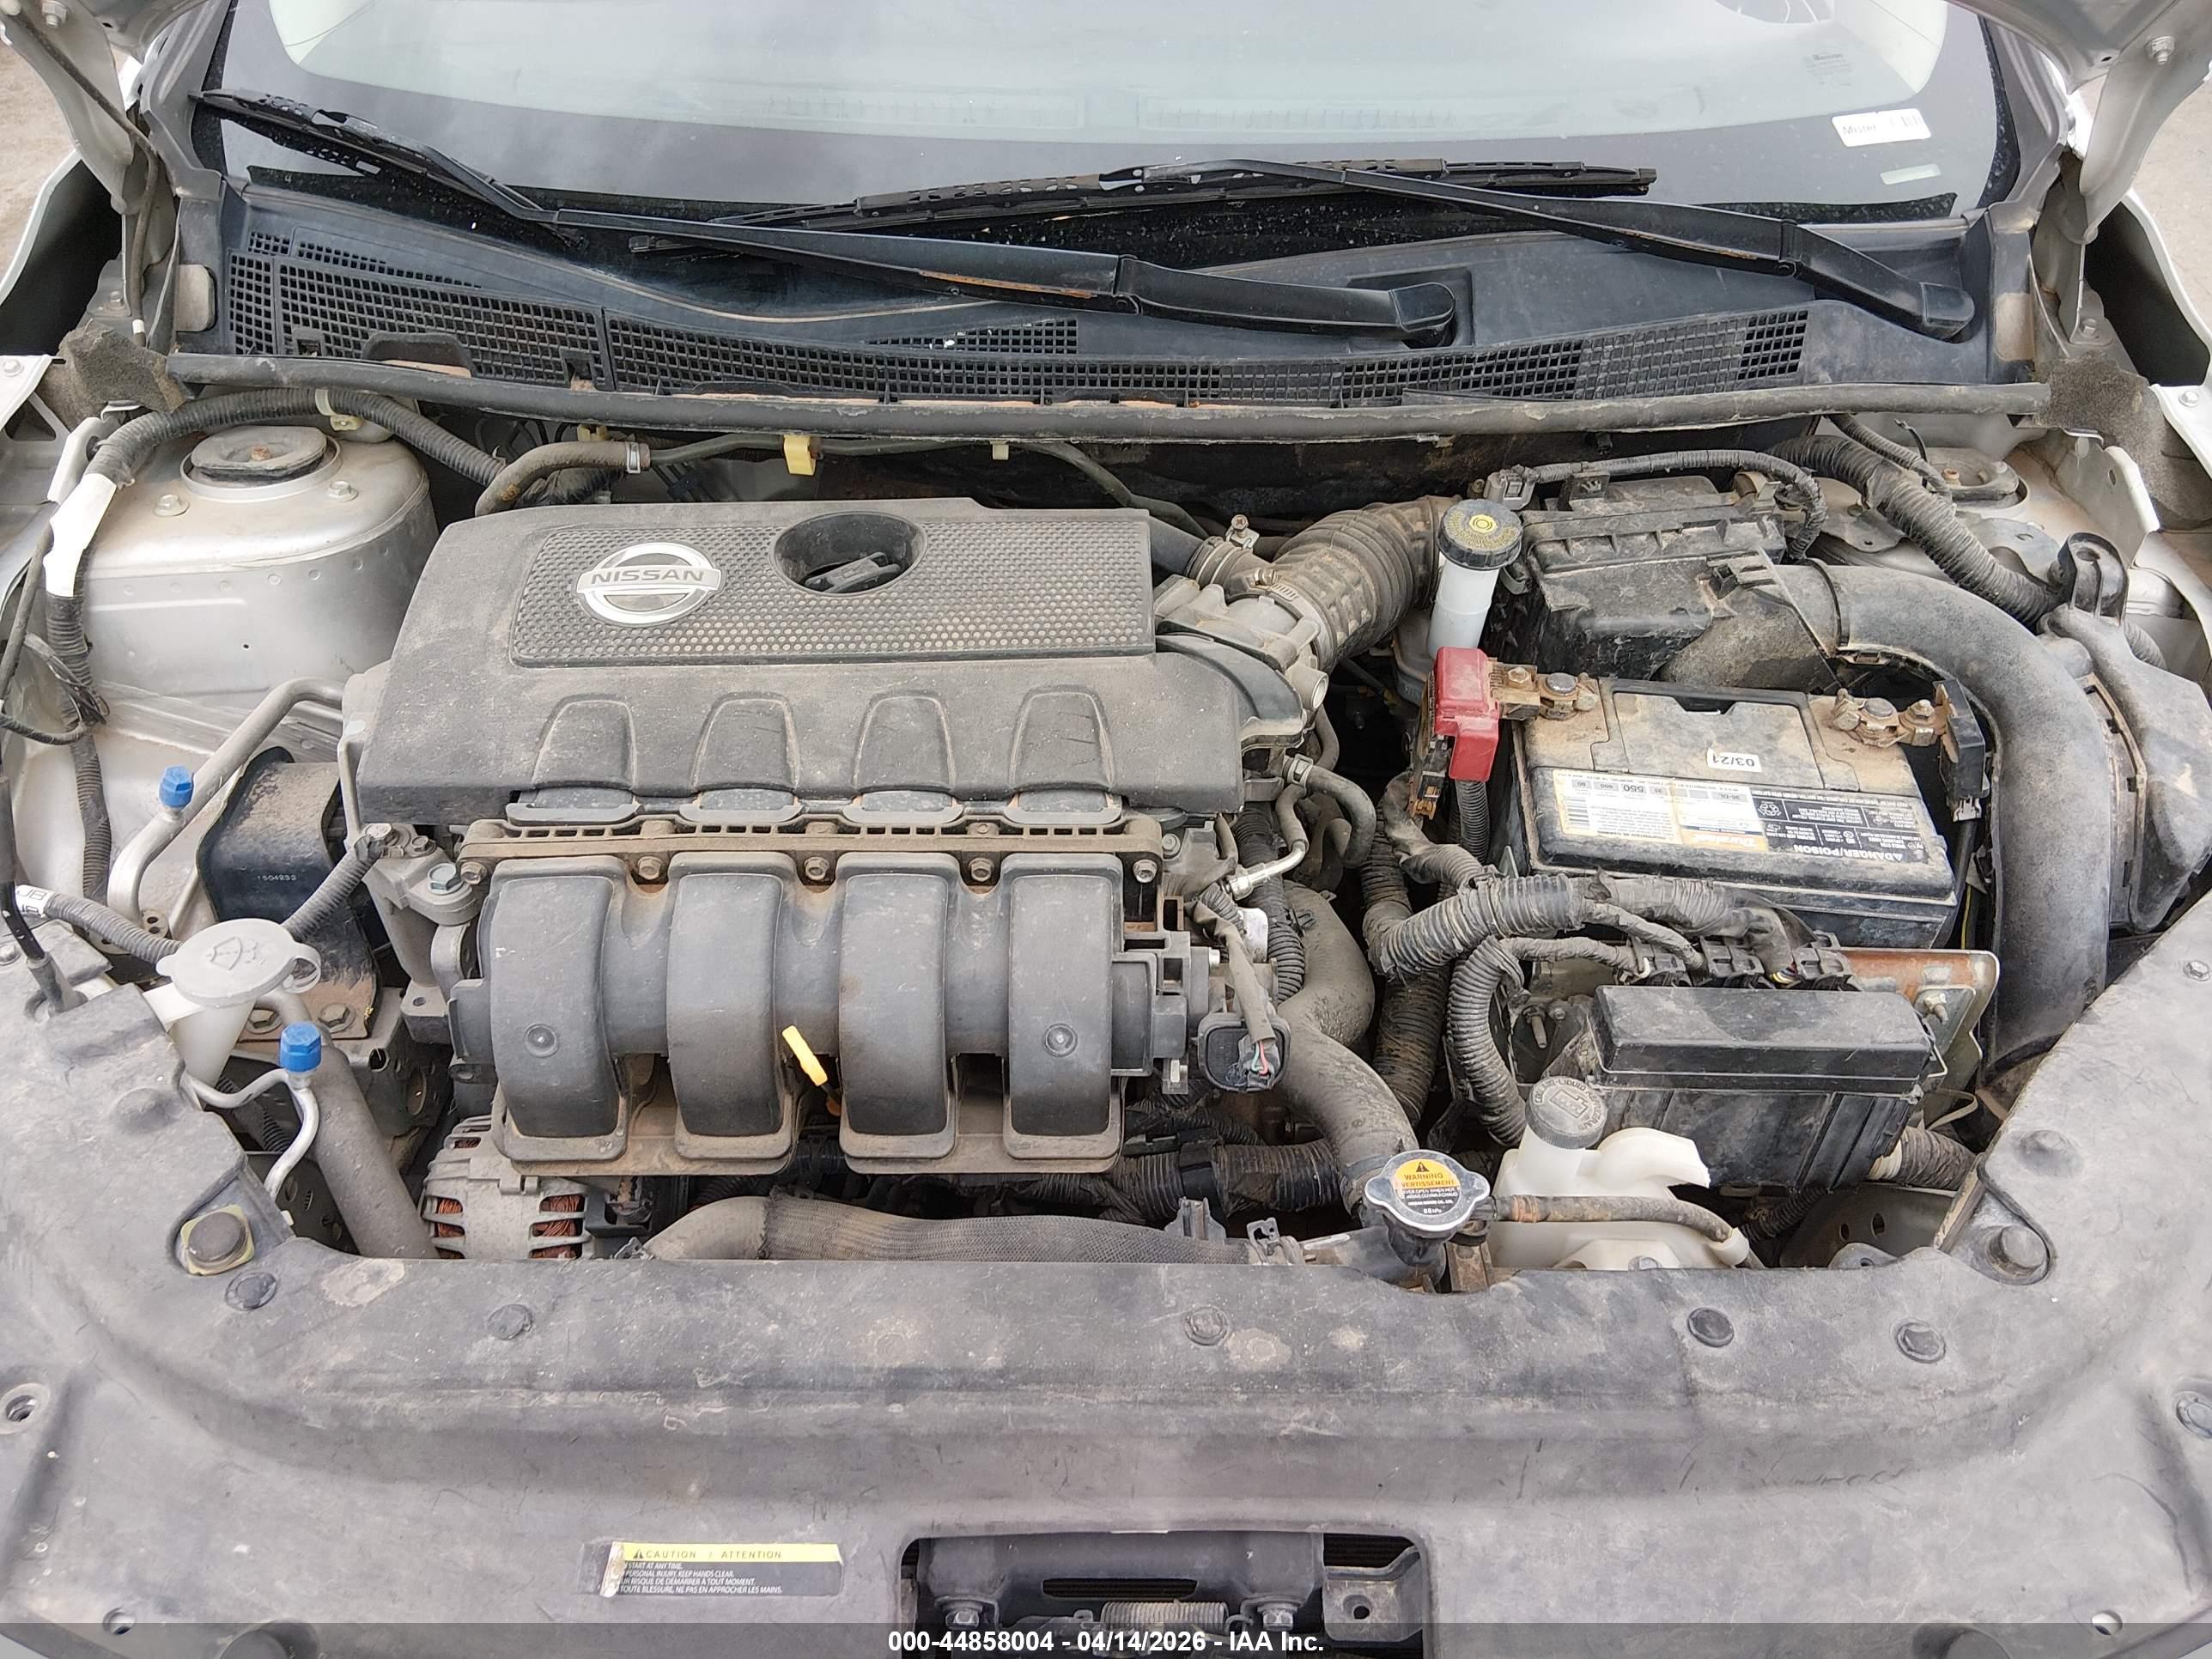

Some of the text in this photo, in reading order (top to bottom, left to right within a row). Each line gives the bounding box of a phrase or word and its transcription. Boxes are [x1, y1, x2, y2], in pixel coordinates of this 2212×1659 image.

[591, 568, 704, 585] NISSAN
[1712, 755, 1755, 767] 03/21
[1622, 784, 1644, 793] 550
[1793, 844, 1893, 861] DANGER/POISON
[1404, 1172, 1443, 1181] WARNING
[646, 1550, 696, 1559] CAUTION
[720, 1550, 782, 1559] ATTENTION
[631, 1577, 656, 1586] RISQUE
[655, 1577, 664, 1586] DE
[707, 1577, 724, 1586] TOUT
[619, 1585, 641, 1594] TOUTE
